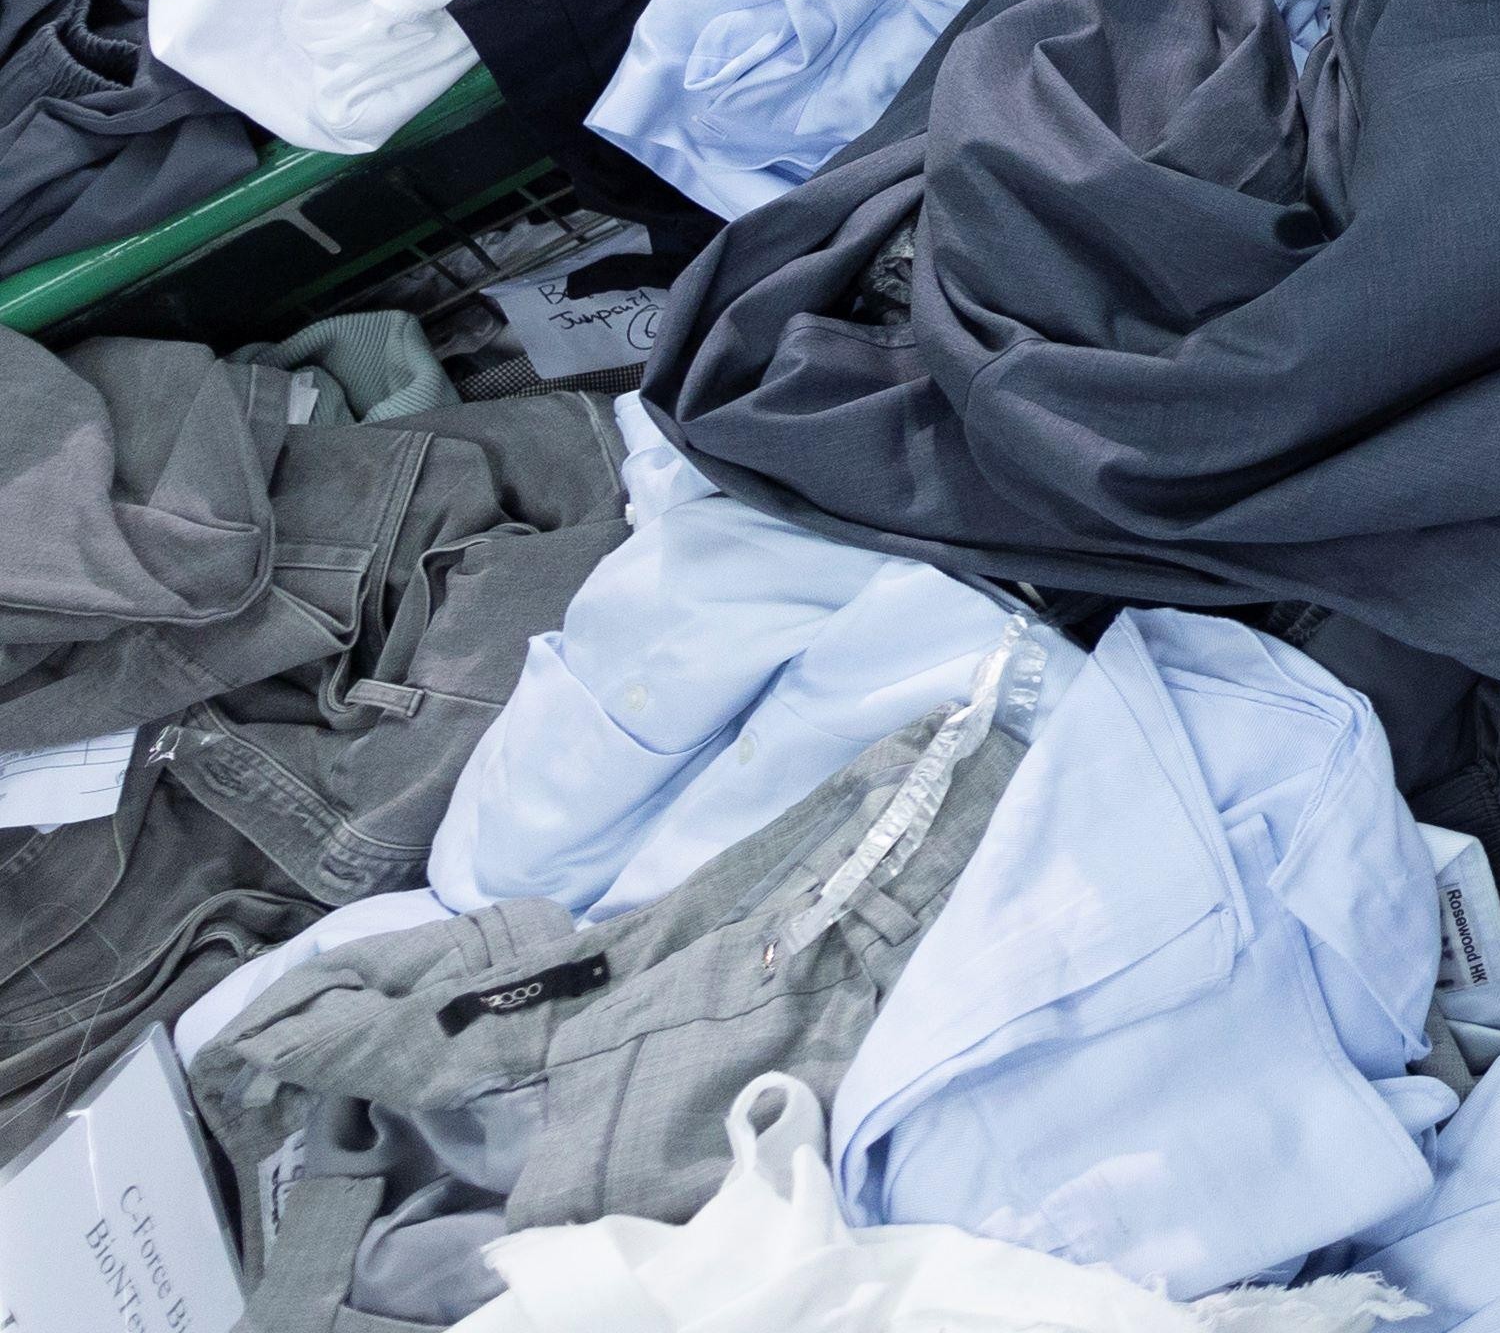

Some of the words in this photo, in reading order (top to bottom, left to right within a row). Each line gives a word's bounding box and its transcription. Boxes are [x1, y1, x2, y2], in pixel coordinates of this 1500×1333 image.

[1446, 888, 1482, 963] Rosewood
[1469, 962, 1488, 984] HK
[119, 1184, 172, 1306] C-Force
